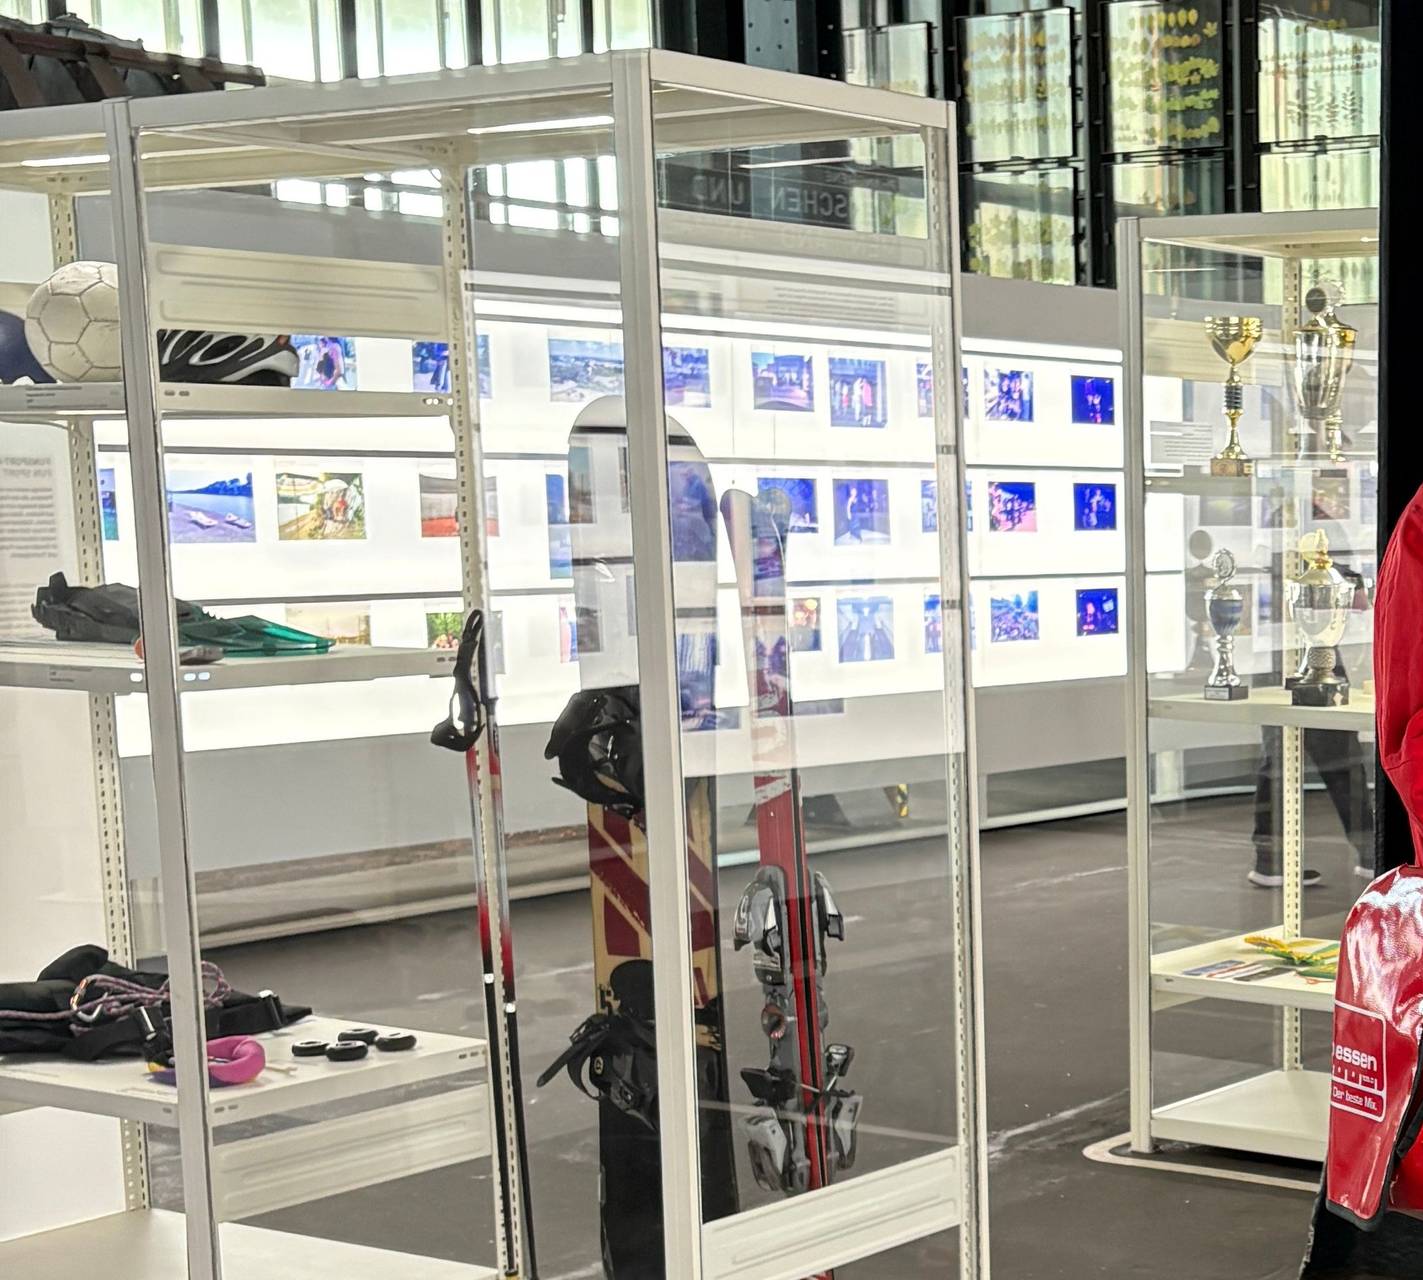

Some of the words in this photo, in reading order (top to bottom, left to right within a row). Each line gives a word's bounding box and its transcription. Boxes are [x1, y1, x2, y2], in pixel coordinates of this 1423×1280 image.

[1335, 1044, 1377, 1071] essen
[1332, 1086, 1345, 1100] Der
[1345, 1089, 1364, 1106] beste
